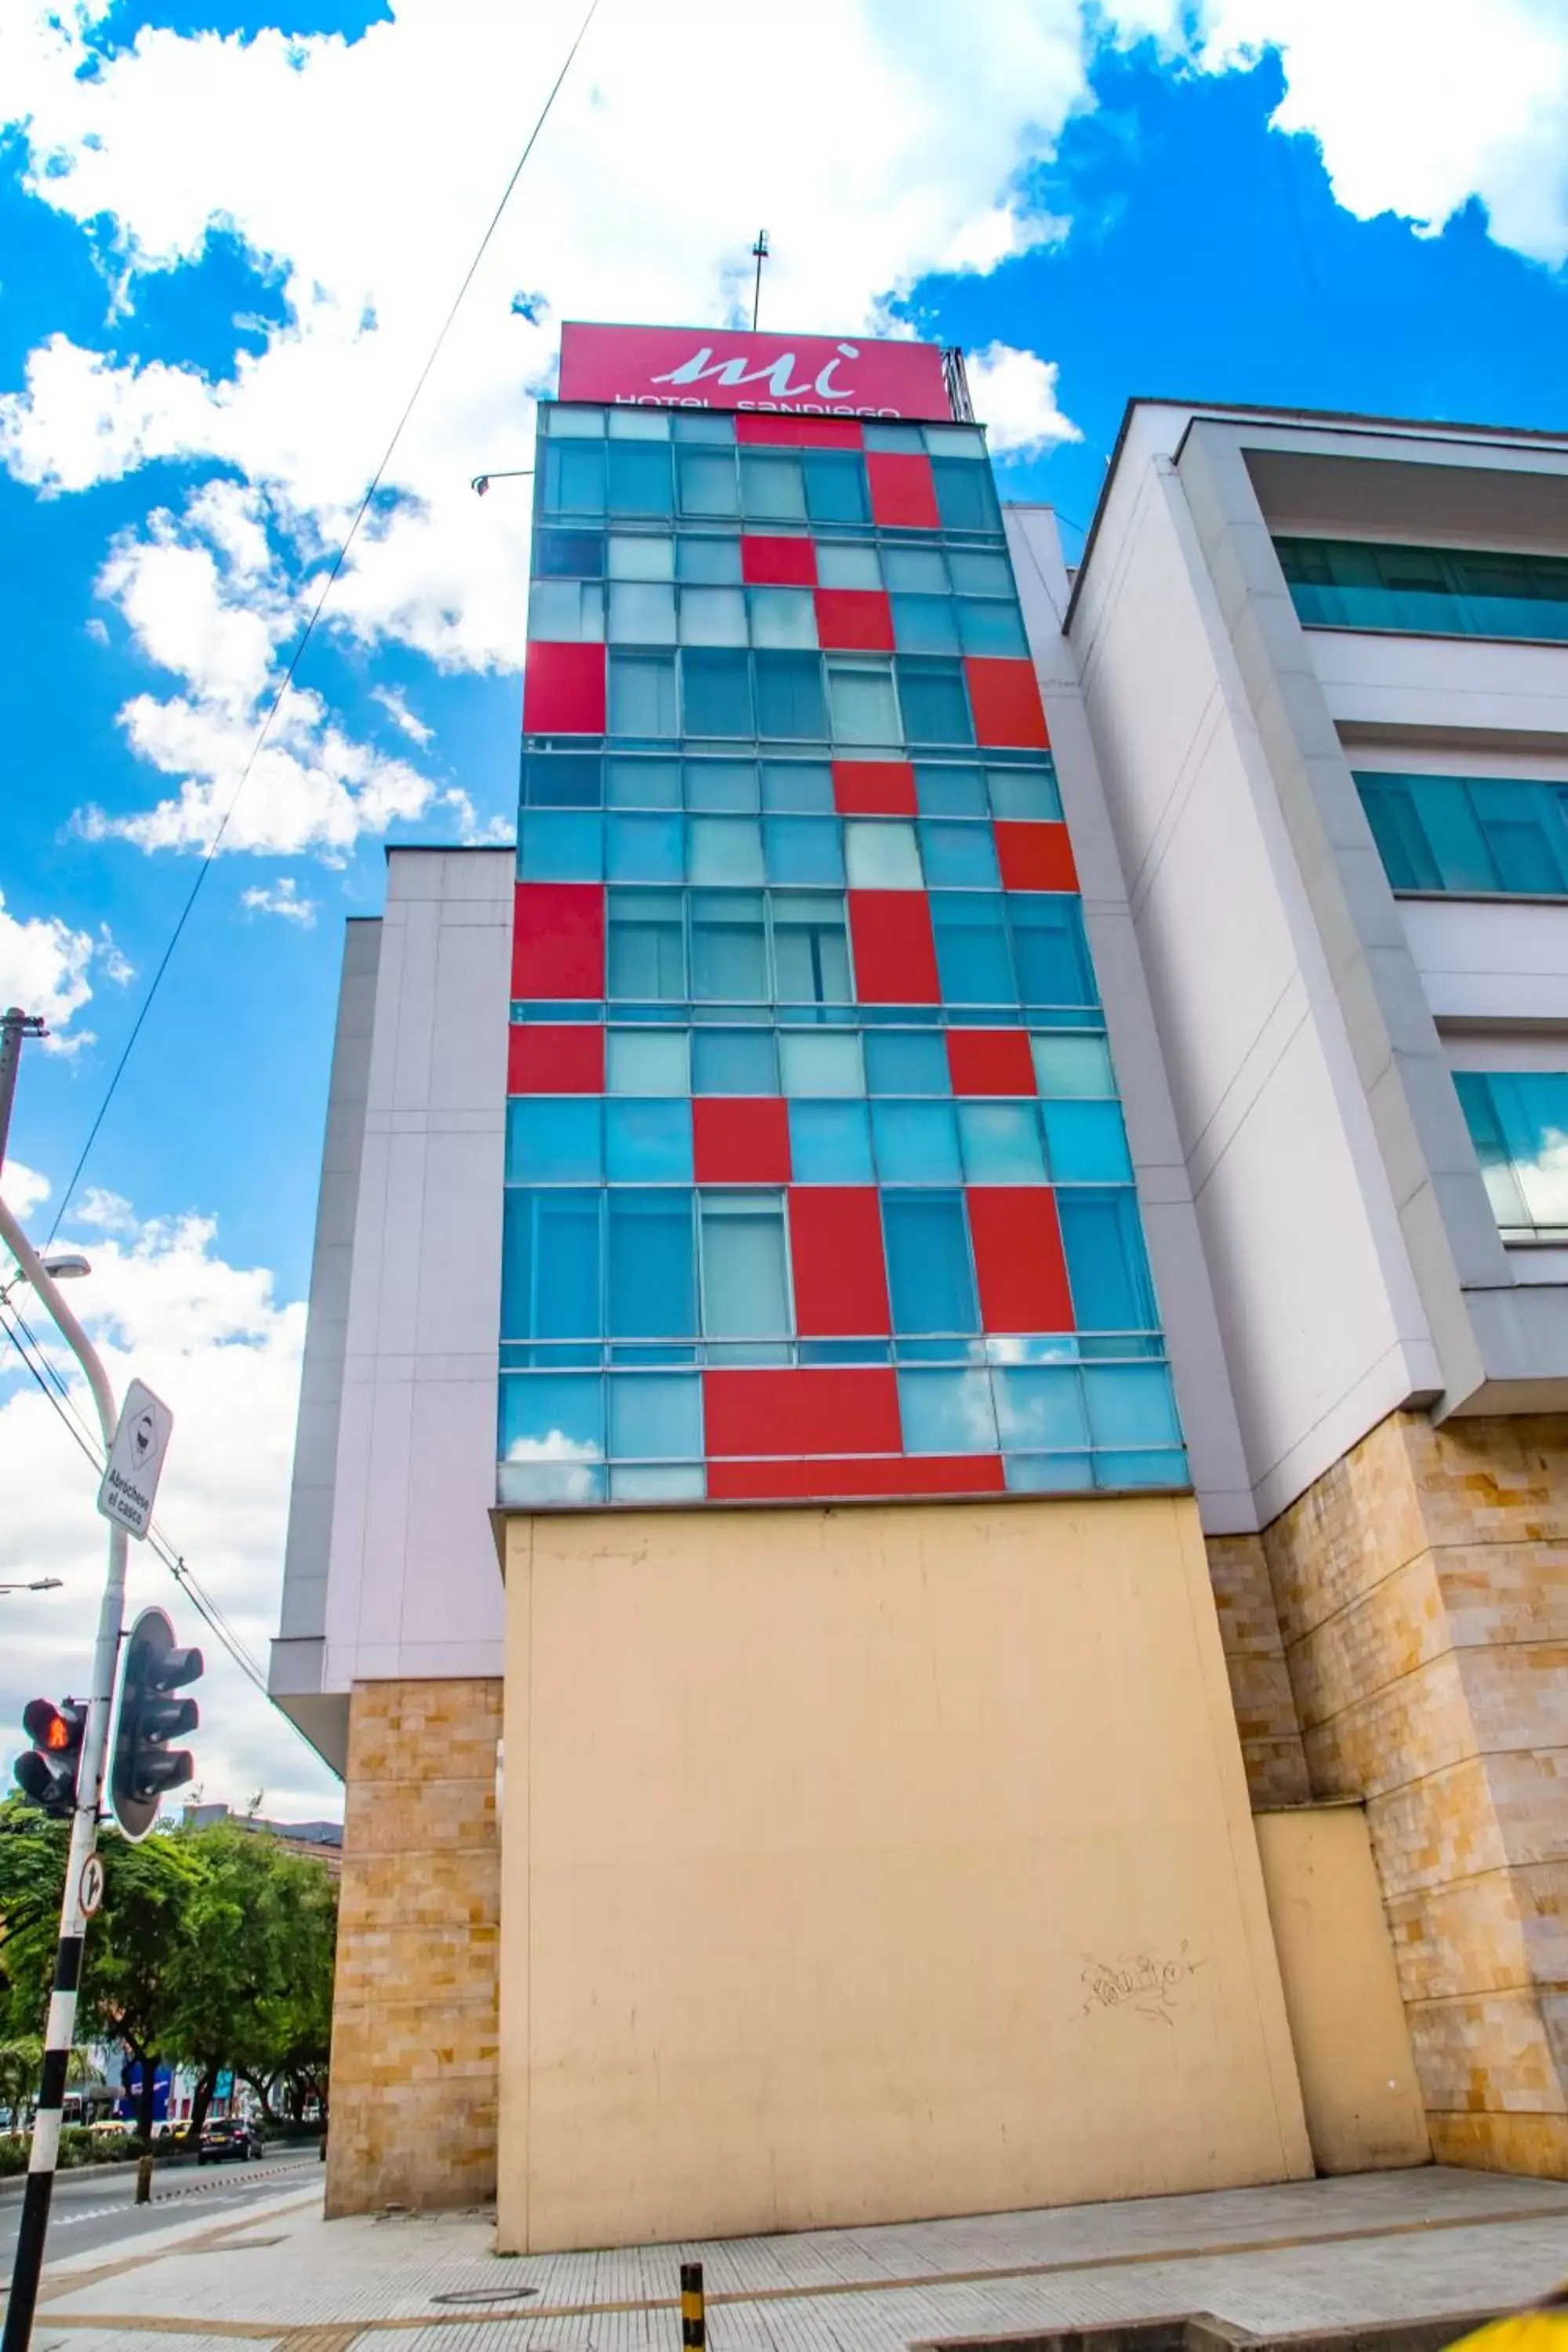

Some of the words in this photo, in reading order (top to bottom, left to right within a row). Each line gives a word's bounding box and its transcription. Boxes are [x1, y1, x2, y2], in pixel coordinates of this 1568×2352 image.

[650, 343, 860, 399] mi
[108, 1492, 118, 1507] el
[118, 1500, 142, 1525] casco
